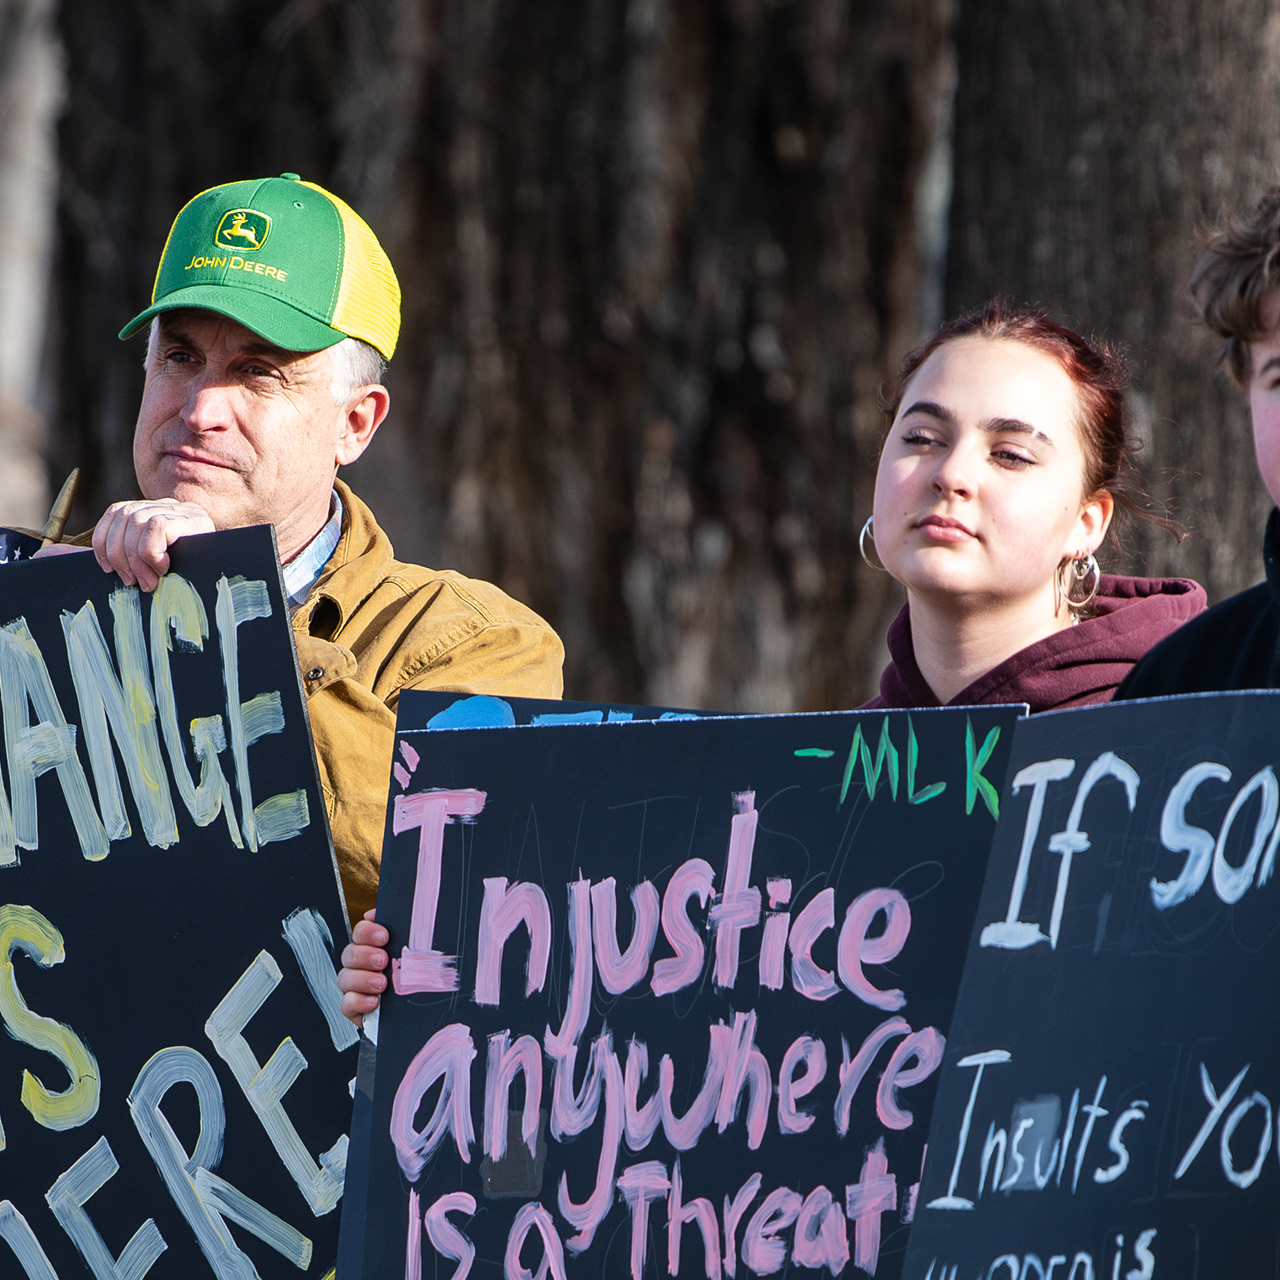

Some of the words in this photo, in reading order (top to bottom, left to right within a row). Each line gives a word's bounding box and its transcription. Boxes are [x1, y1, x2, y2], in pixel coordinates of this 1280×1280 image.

[184, 255, 226, 271] JOHN
[228, 255, 289, 283] DEERE
[389, 1009, 947, 1258] anywhere
[925, 1048, 1150, 1210] Insults
